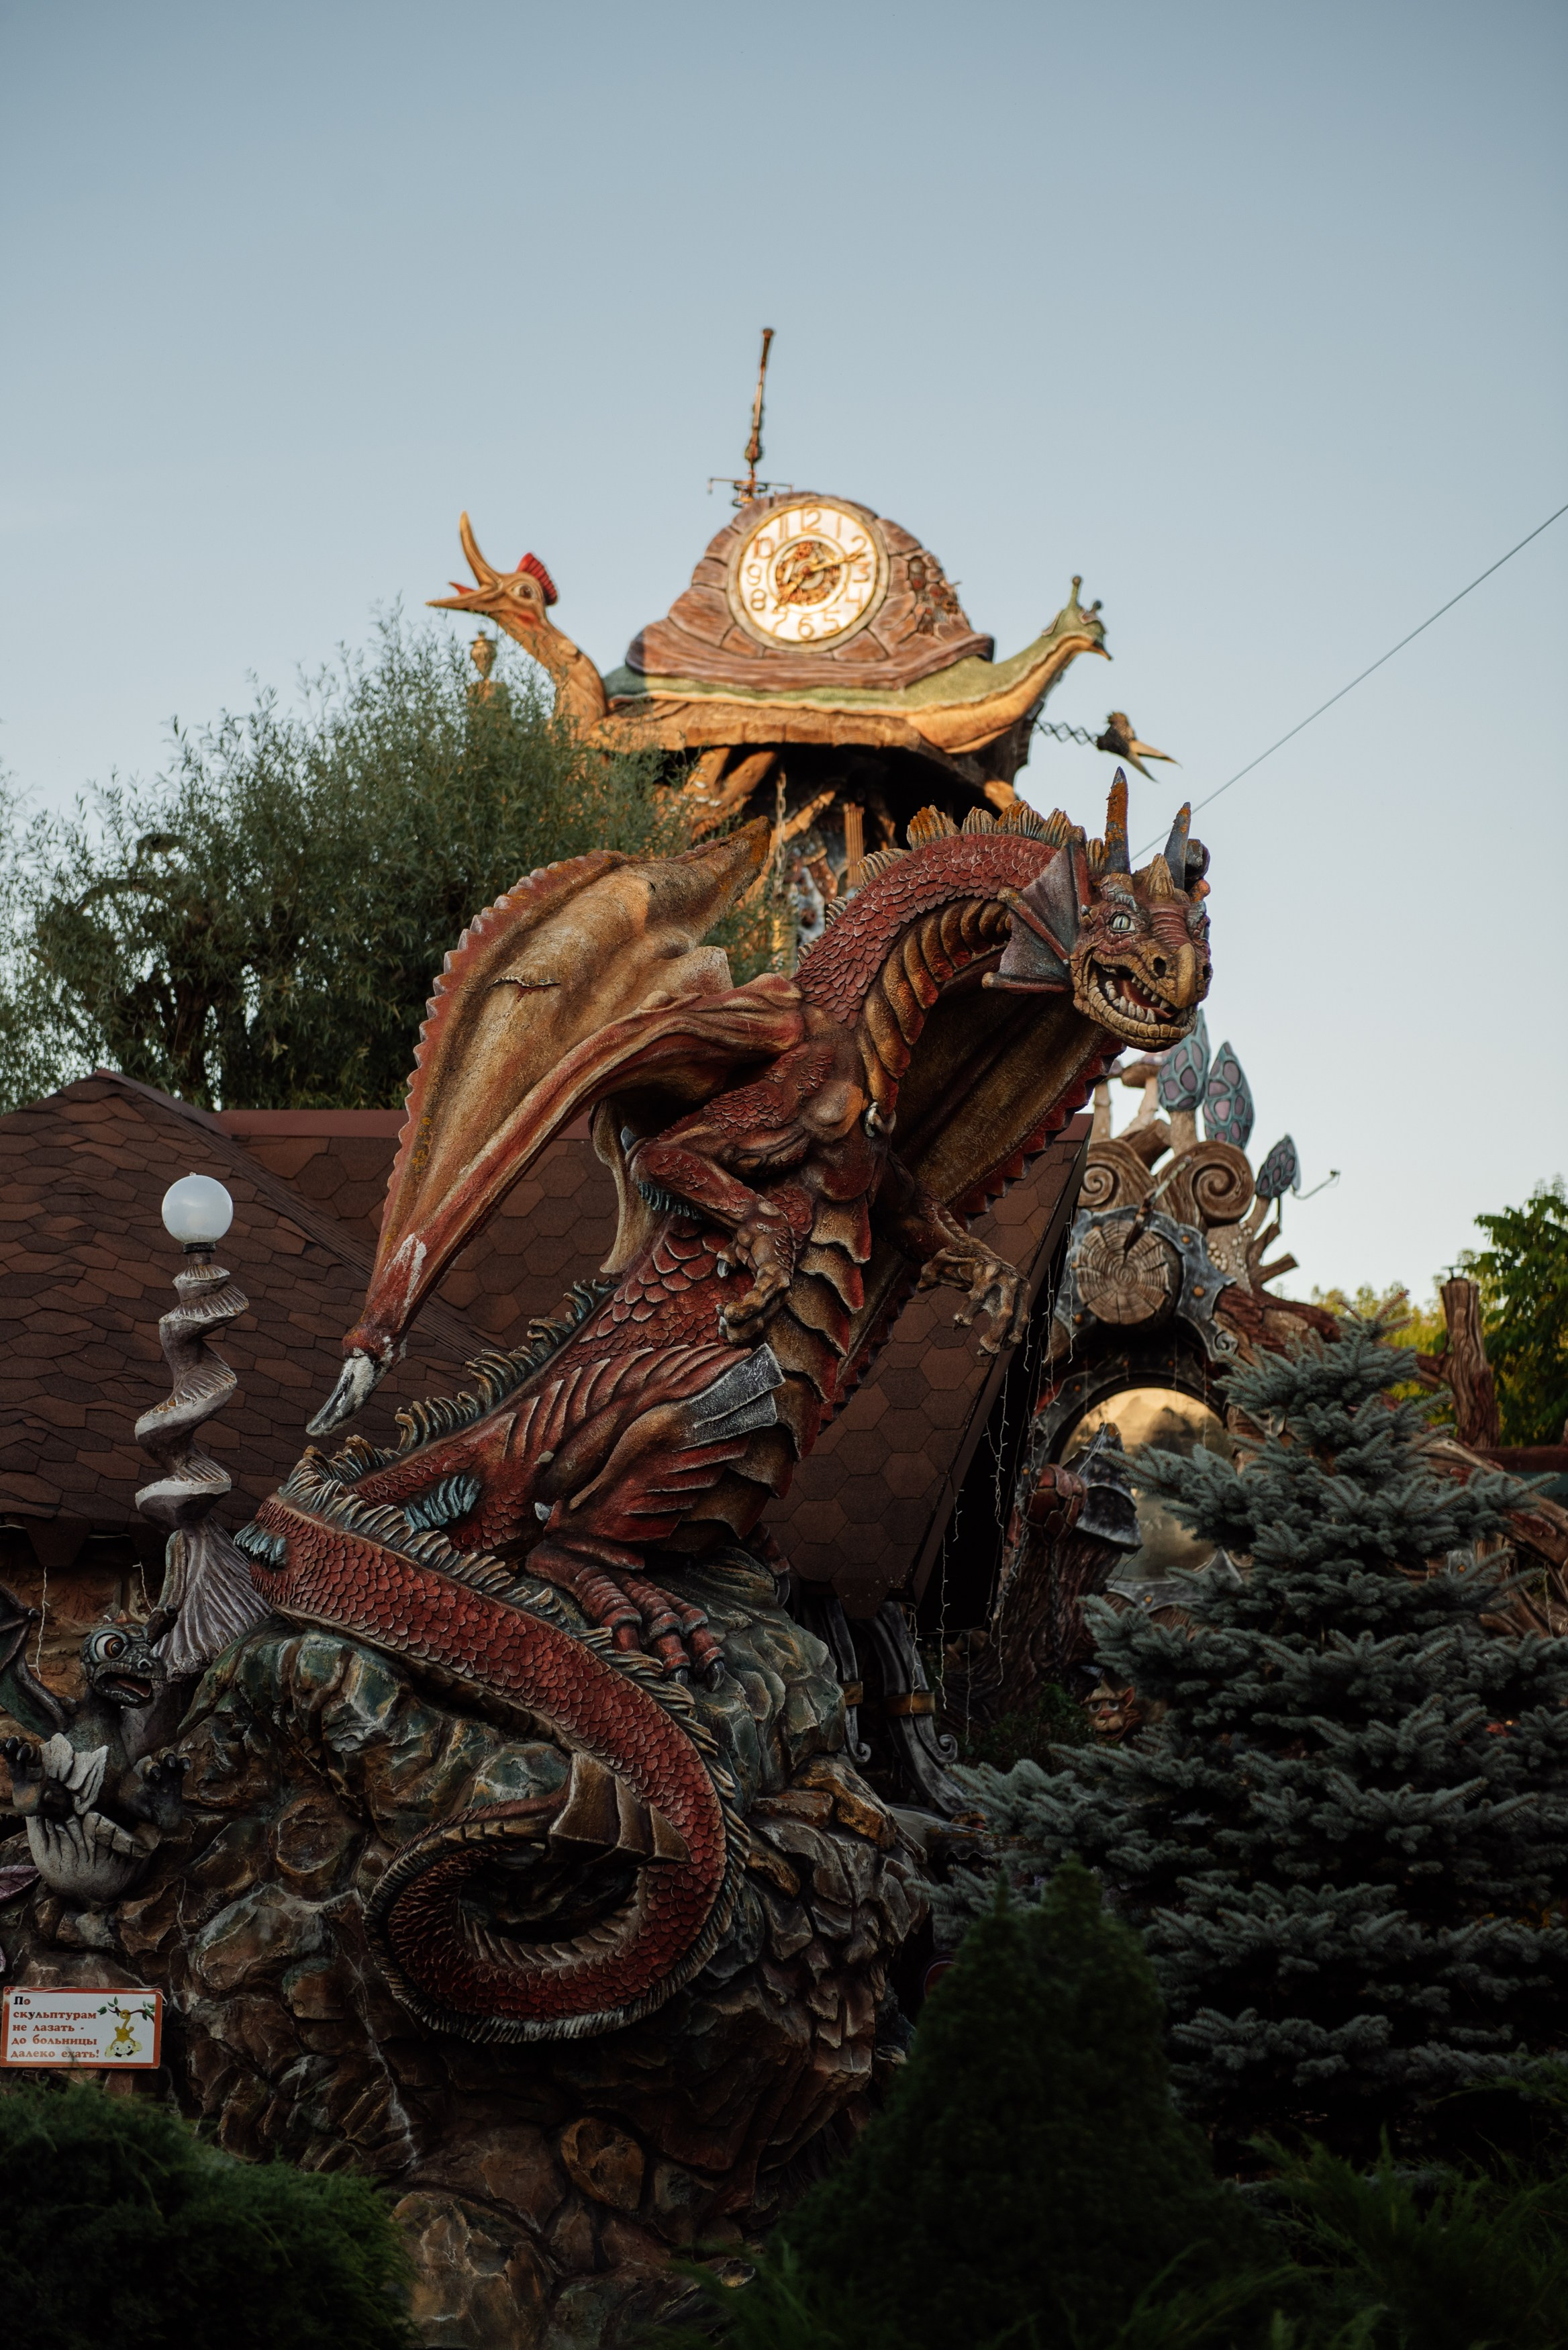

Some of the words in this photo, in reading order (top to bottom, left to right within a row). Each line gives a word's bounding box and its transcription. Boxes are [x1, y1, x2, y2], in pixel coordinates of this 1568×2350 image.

[779, 516, 789, 539] 11
[801, 509, 822, 532] 12
[836, 516, 842, 538] 1
[754, 536, 775, 559] 10
[851, 536, 867, 557] 2
[746, 564, 762, 585] 9
[850, 561, 871, 583] 3
[750, 588, 766, 612] 8
[845, 588, 863, 613] 4
[773, 609, 789, 634] 7
[798, 614, 814, 639] 6
[824, 610, 840, 634] 5
[13, 1996, 31, 2005] По
[13, 2012, 97, 2020] скульптурам
[33, 2034, 97, 2045] больницы
[11, 2050, 55, 2058] далеко
[61, 2050, 99, 2058] ехать!
